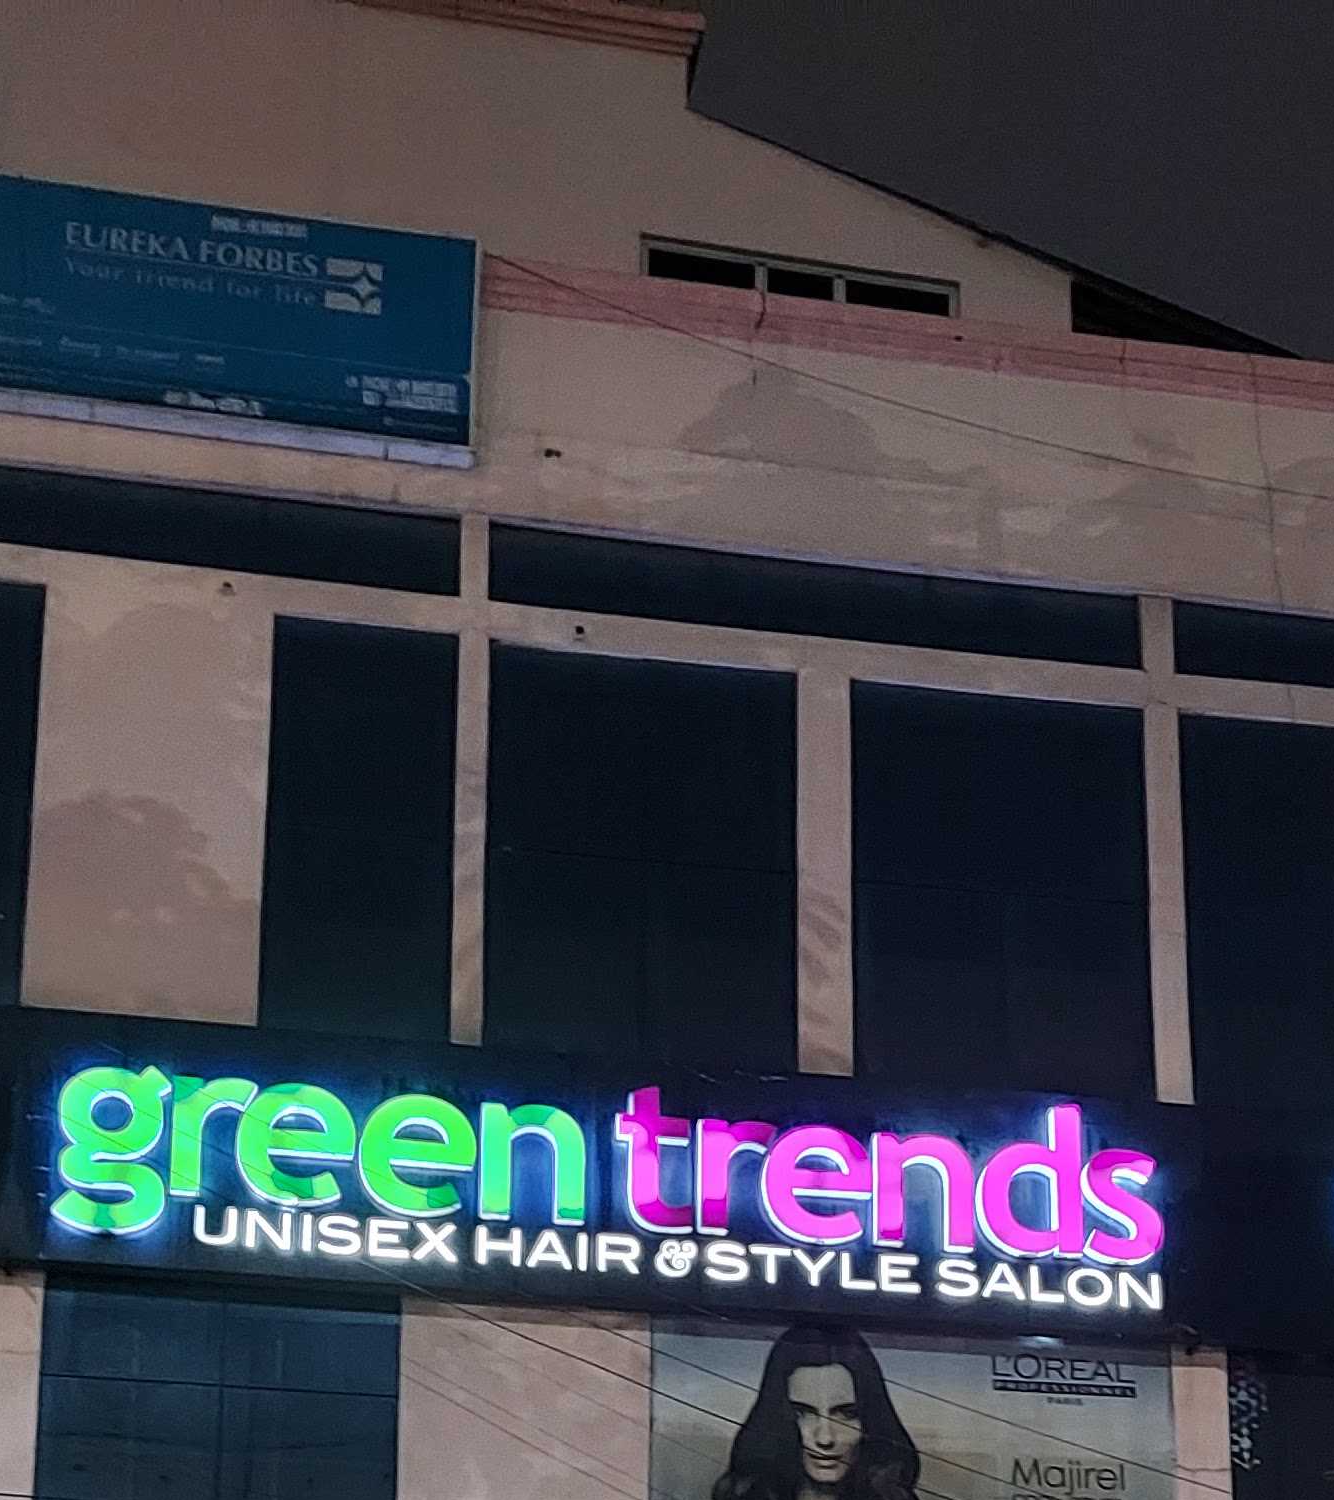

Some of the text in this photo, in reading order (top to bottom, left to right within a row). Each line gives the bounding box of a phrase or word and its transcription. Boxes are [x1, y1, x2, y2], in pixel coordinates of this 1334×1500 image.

[66, 221, 191, 262] EUREKA
[198, 238, 318, 277] FORBES
[49, 1065, 1165, 1268] green trends
[189, 1201, 1166, 1312] UNISEX HAIR & STYLE SALON
[1012, 1458, 1127, 1495] Majirel
